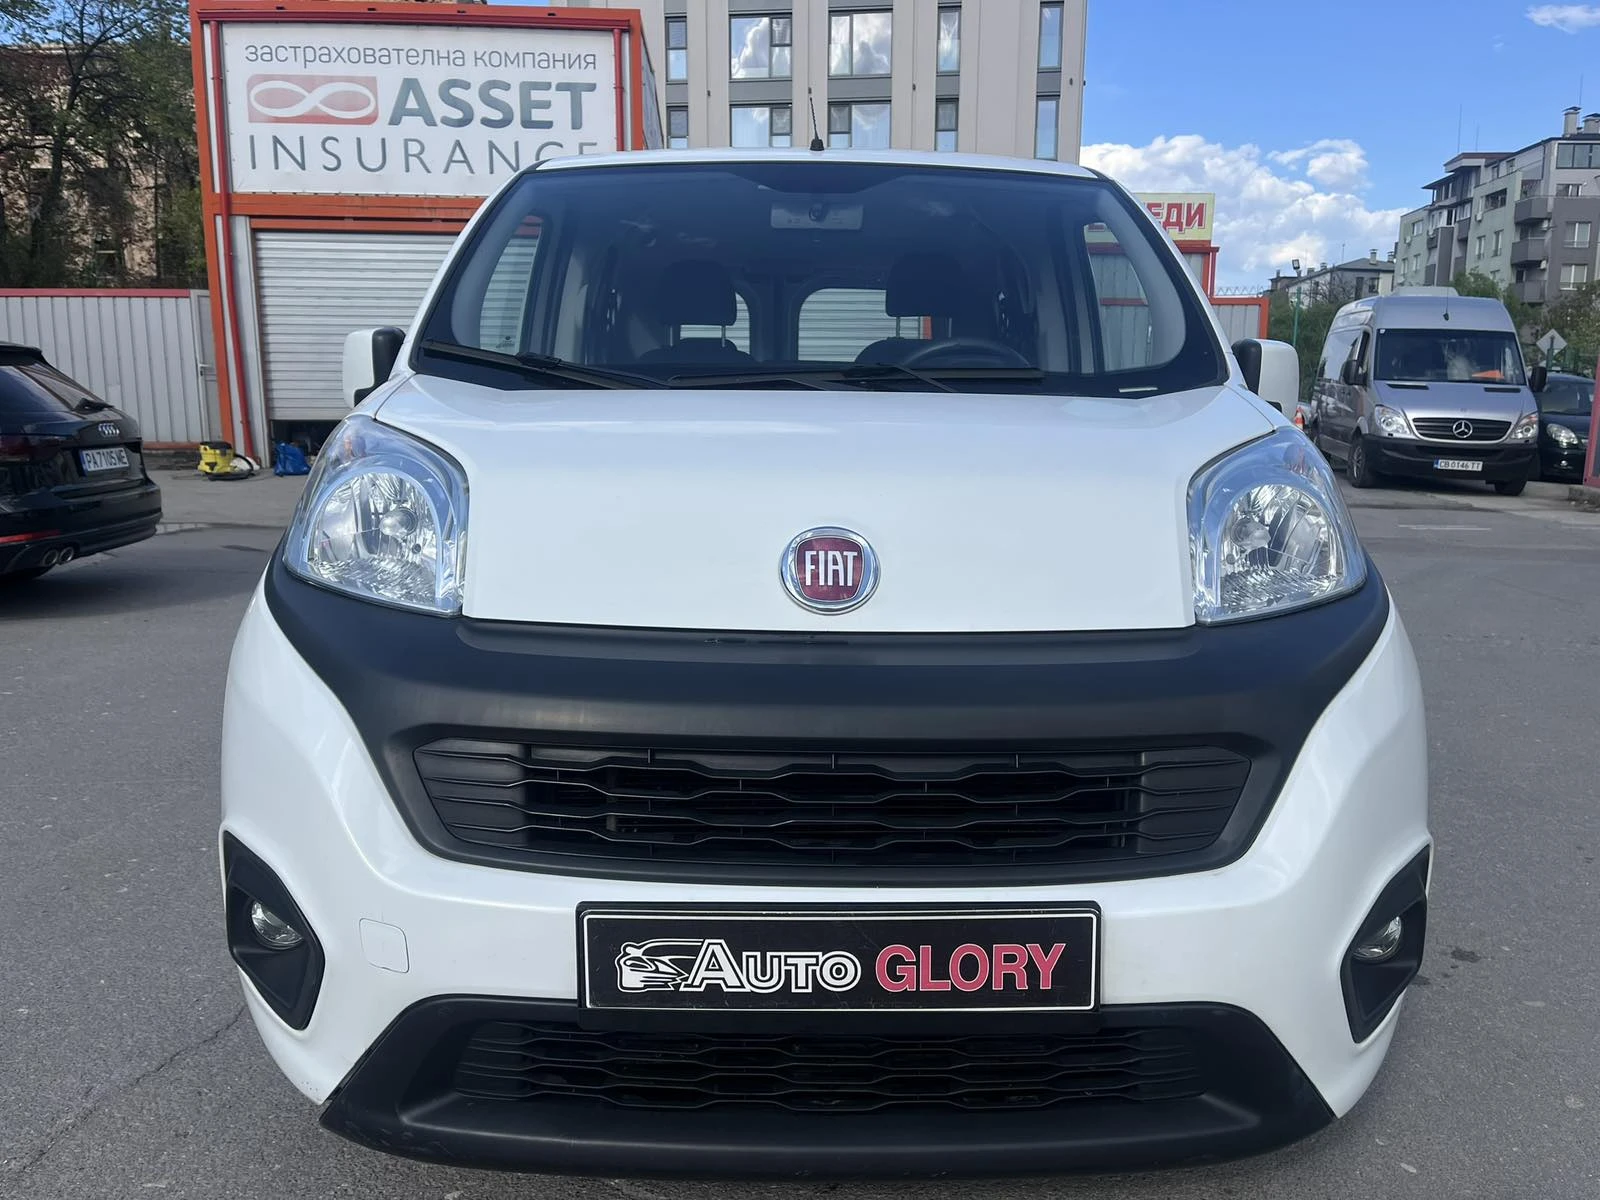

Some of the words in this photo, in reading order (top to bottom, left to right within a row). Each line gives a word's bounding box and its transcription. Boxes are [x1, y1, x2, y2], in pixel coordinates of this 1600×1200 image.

[245, 44, 465, 68] застрахователна
[474, 50, 597, 70] компания
[388, 77, 597, 130] ASSET
[805, 550, 858, 587] FIAT
[875, 943, 1066, 991] GLORY
